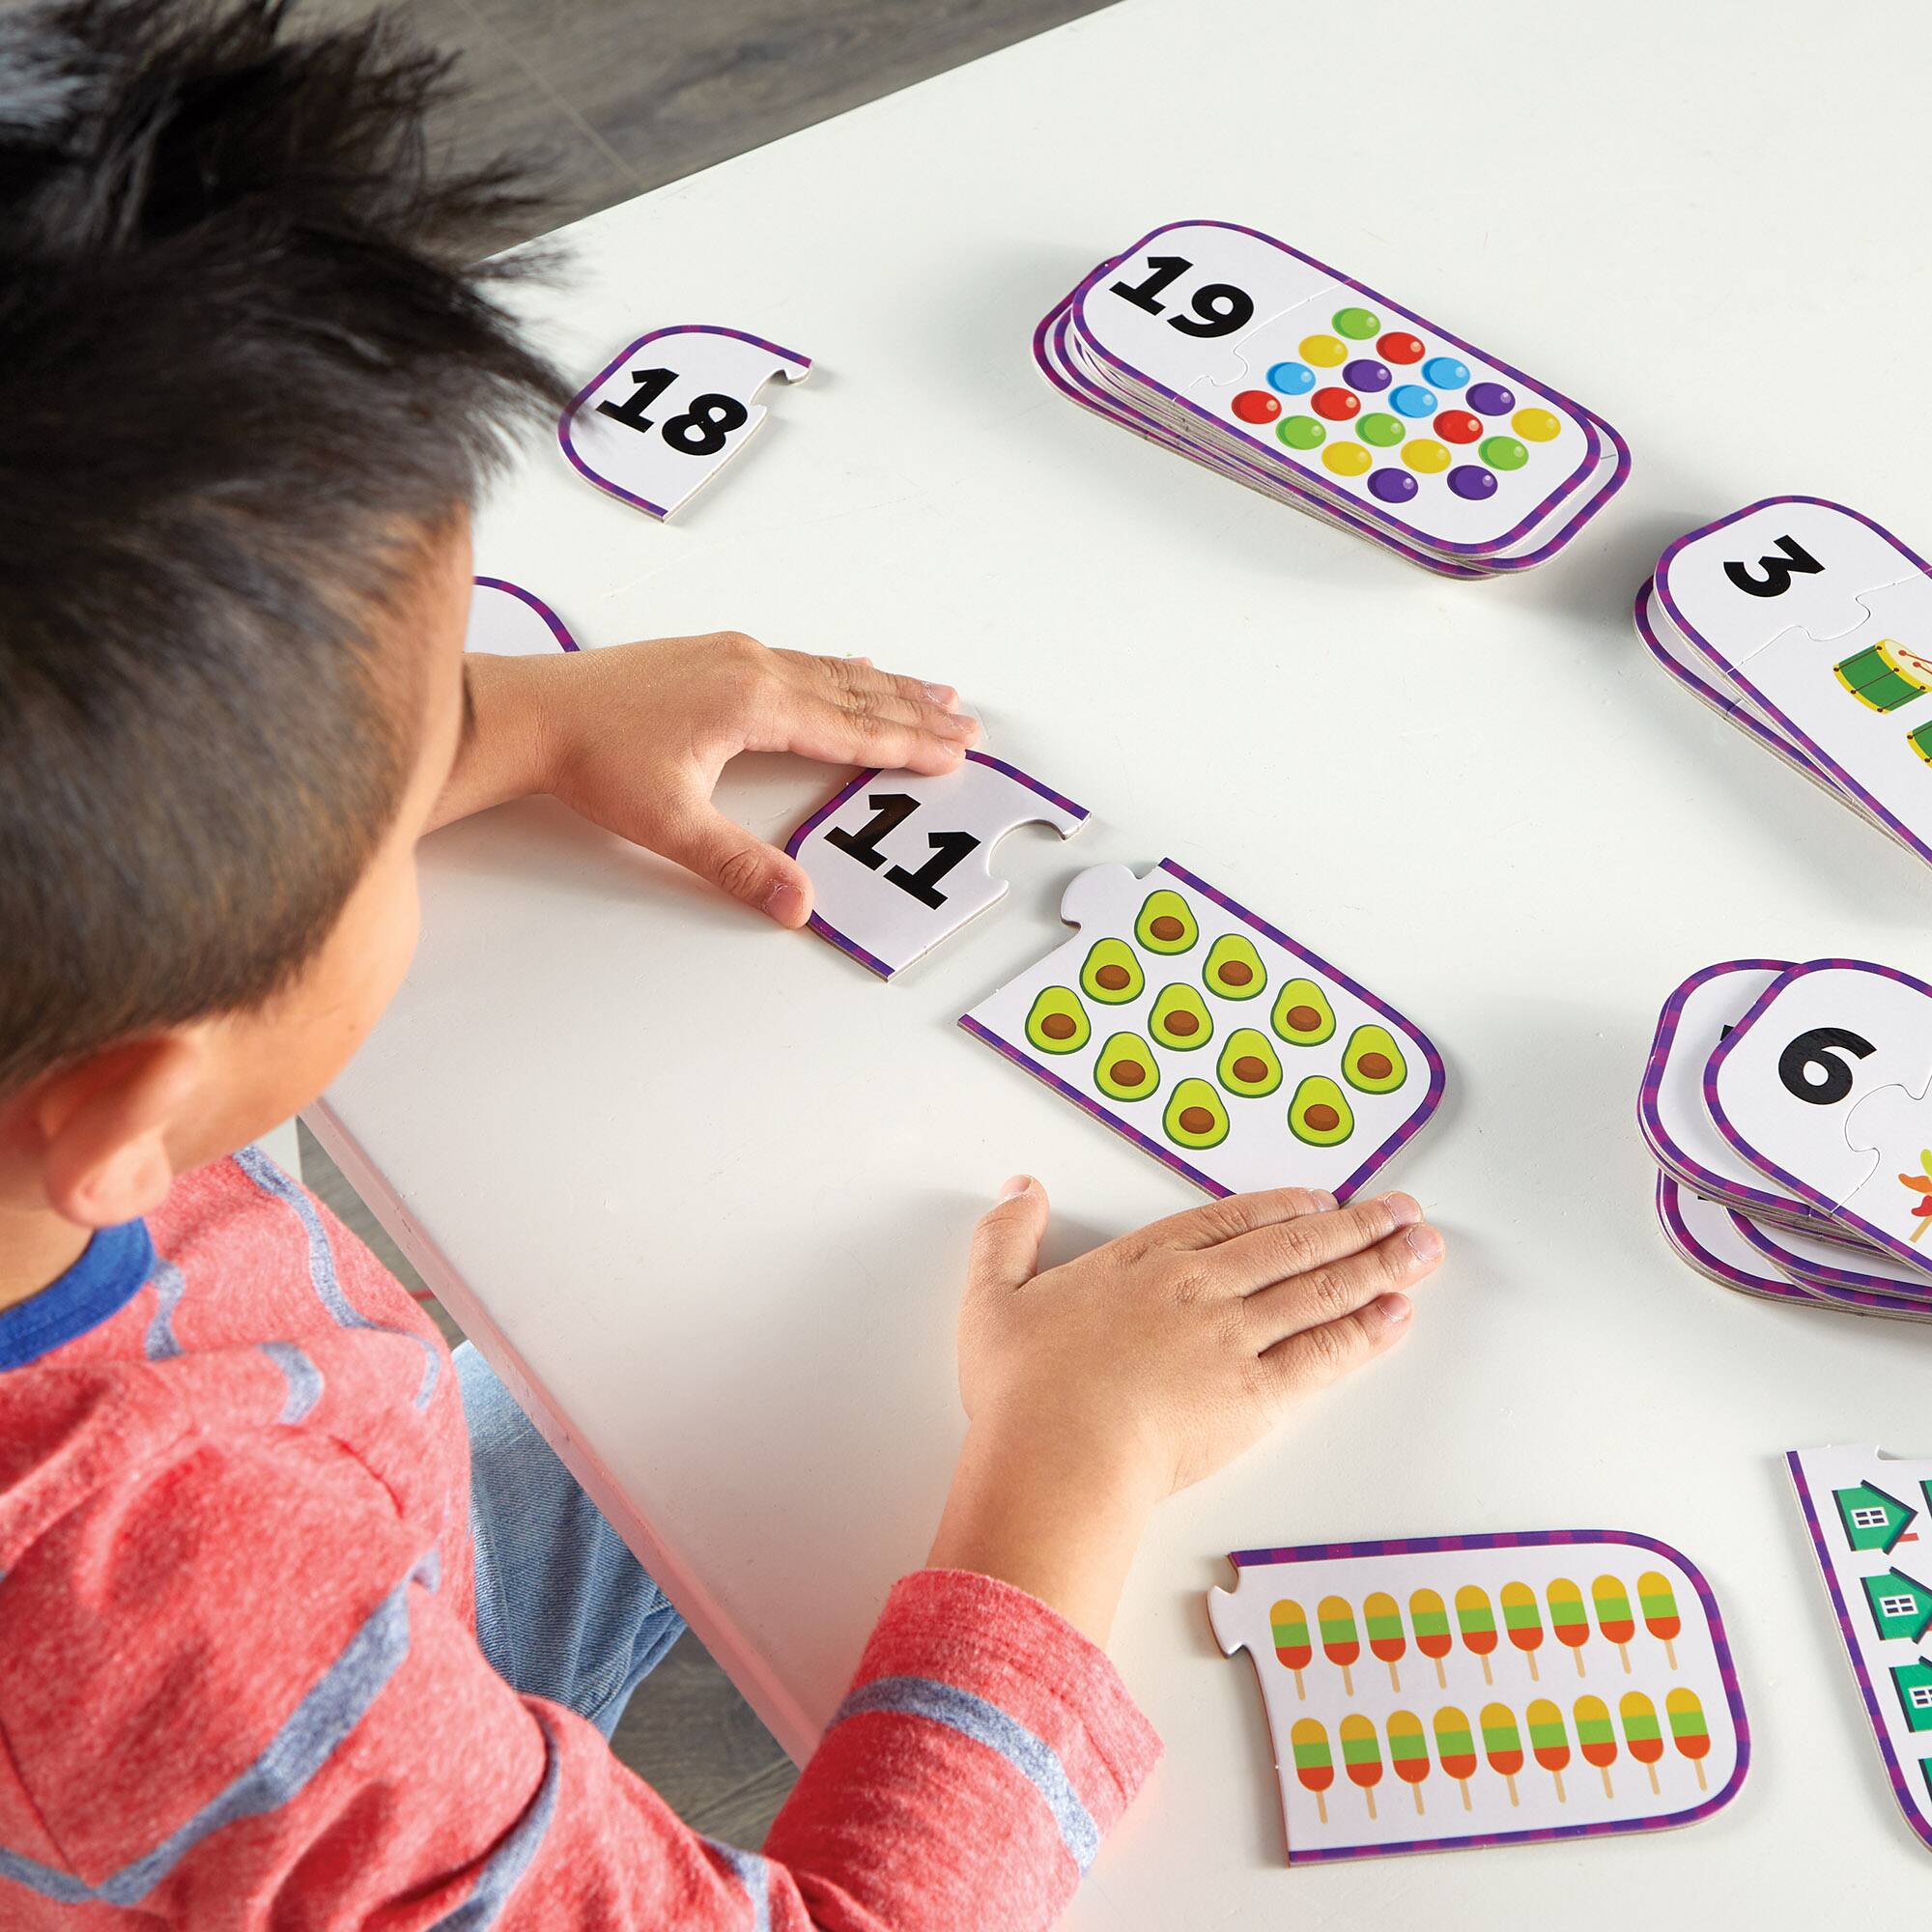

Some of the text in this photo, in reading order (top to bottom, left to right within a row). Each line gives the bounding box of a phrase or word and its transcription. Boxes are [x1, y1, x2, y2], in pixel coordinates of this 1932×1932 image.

[1109, 255, 1255, 339] 19
[595, 367, 748, 457] 18
[1722, 533, 1826, 598] 3
[824, 792, 982, 911] 11
[1777, 1026, 1877, 1105] 6
